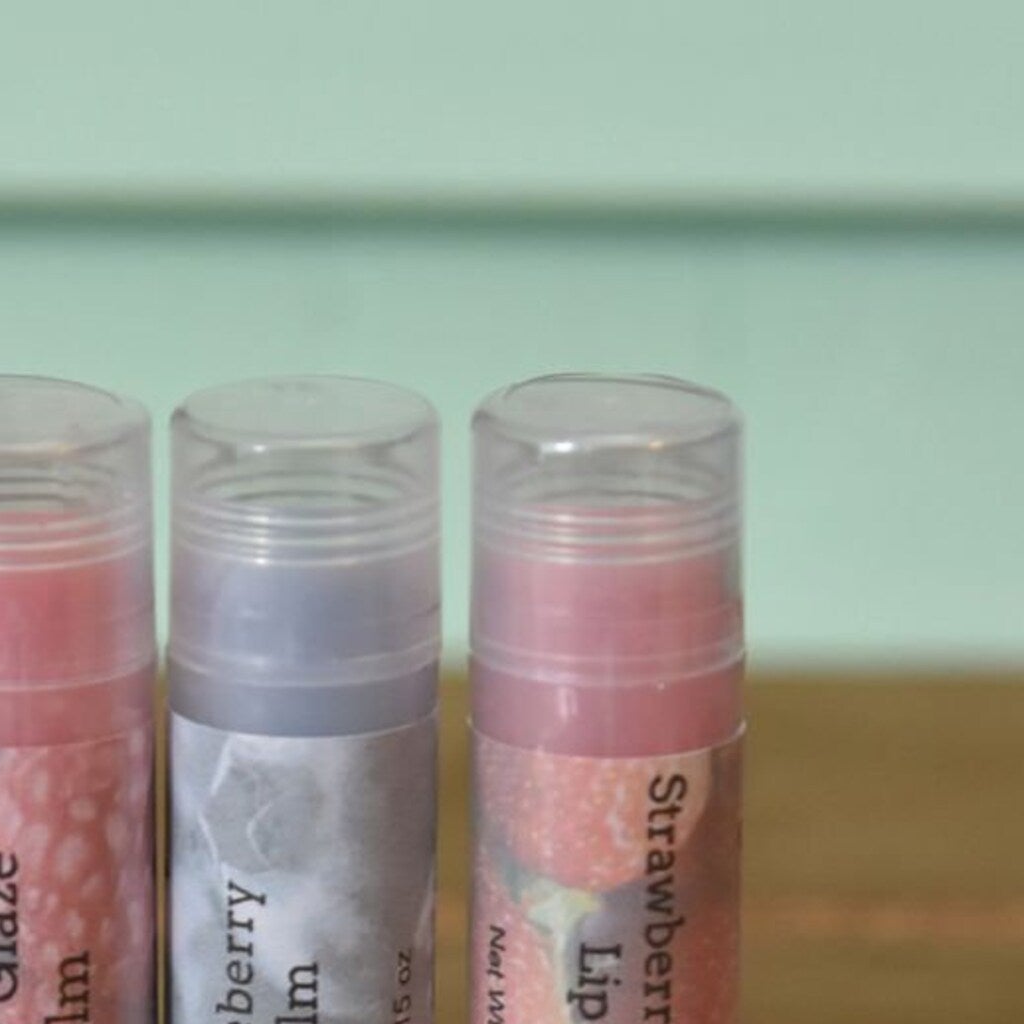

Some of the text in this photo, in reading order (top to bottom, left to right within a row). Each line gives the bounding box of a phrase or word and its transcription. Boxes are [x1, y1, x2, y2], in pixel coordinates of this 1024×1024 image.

[397, 948, 413, 987] oz
[485, 925, 507, 980] Net
[569, 942, 622, 1023] Lip
